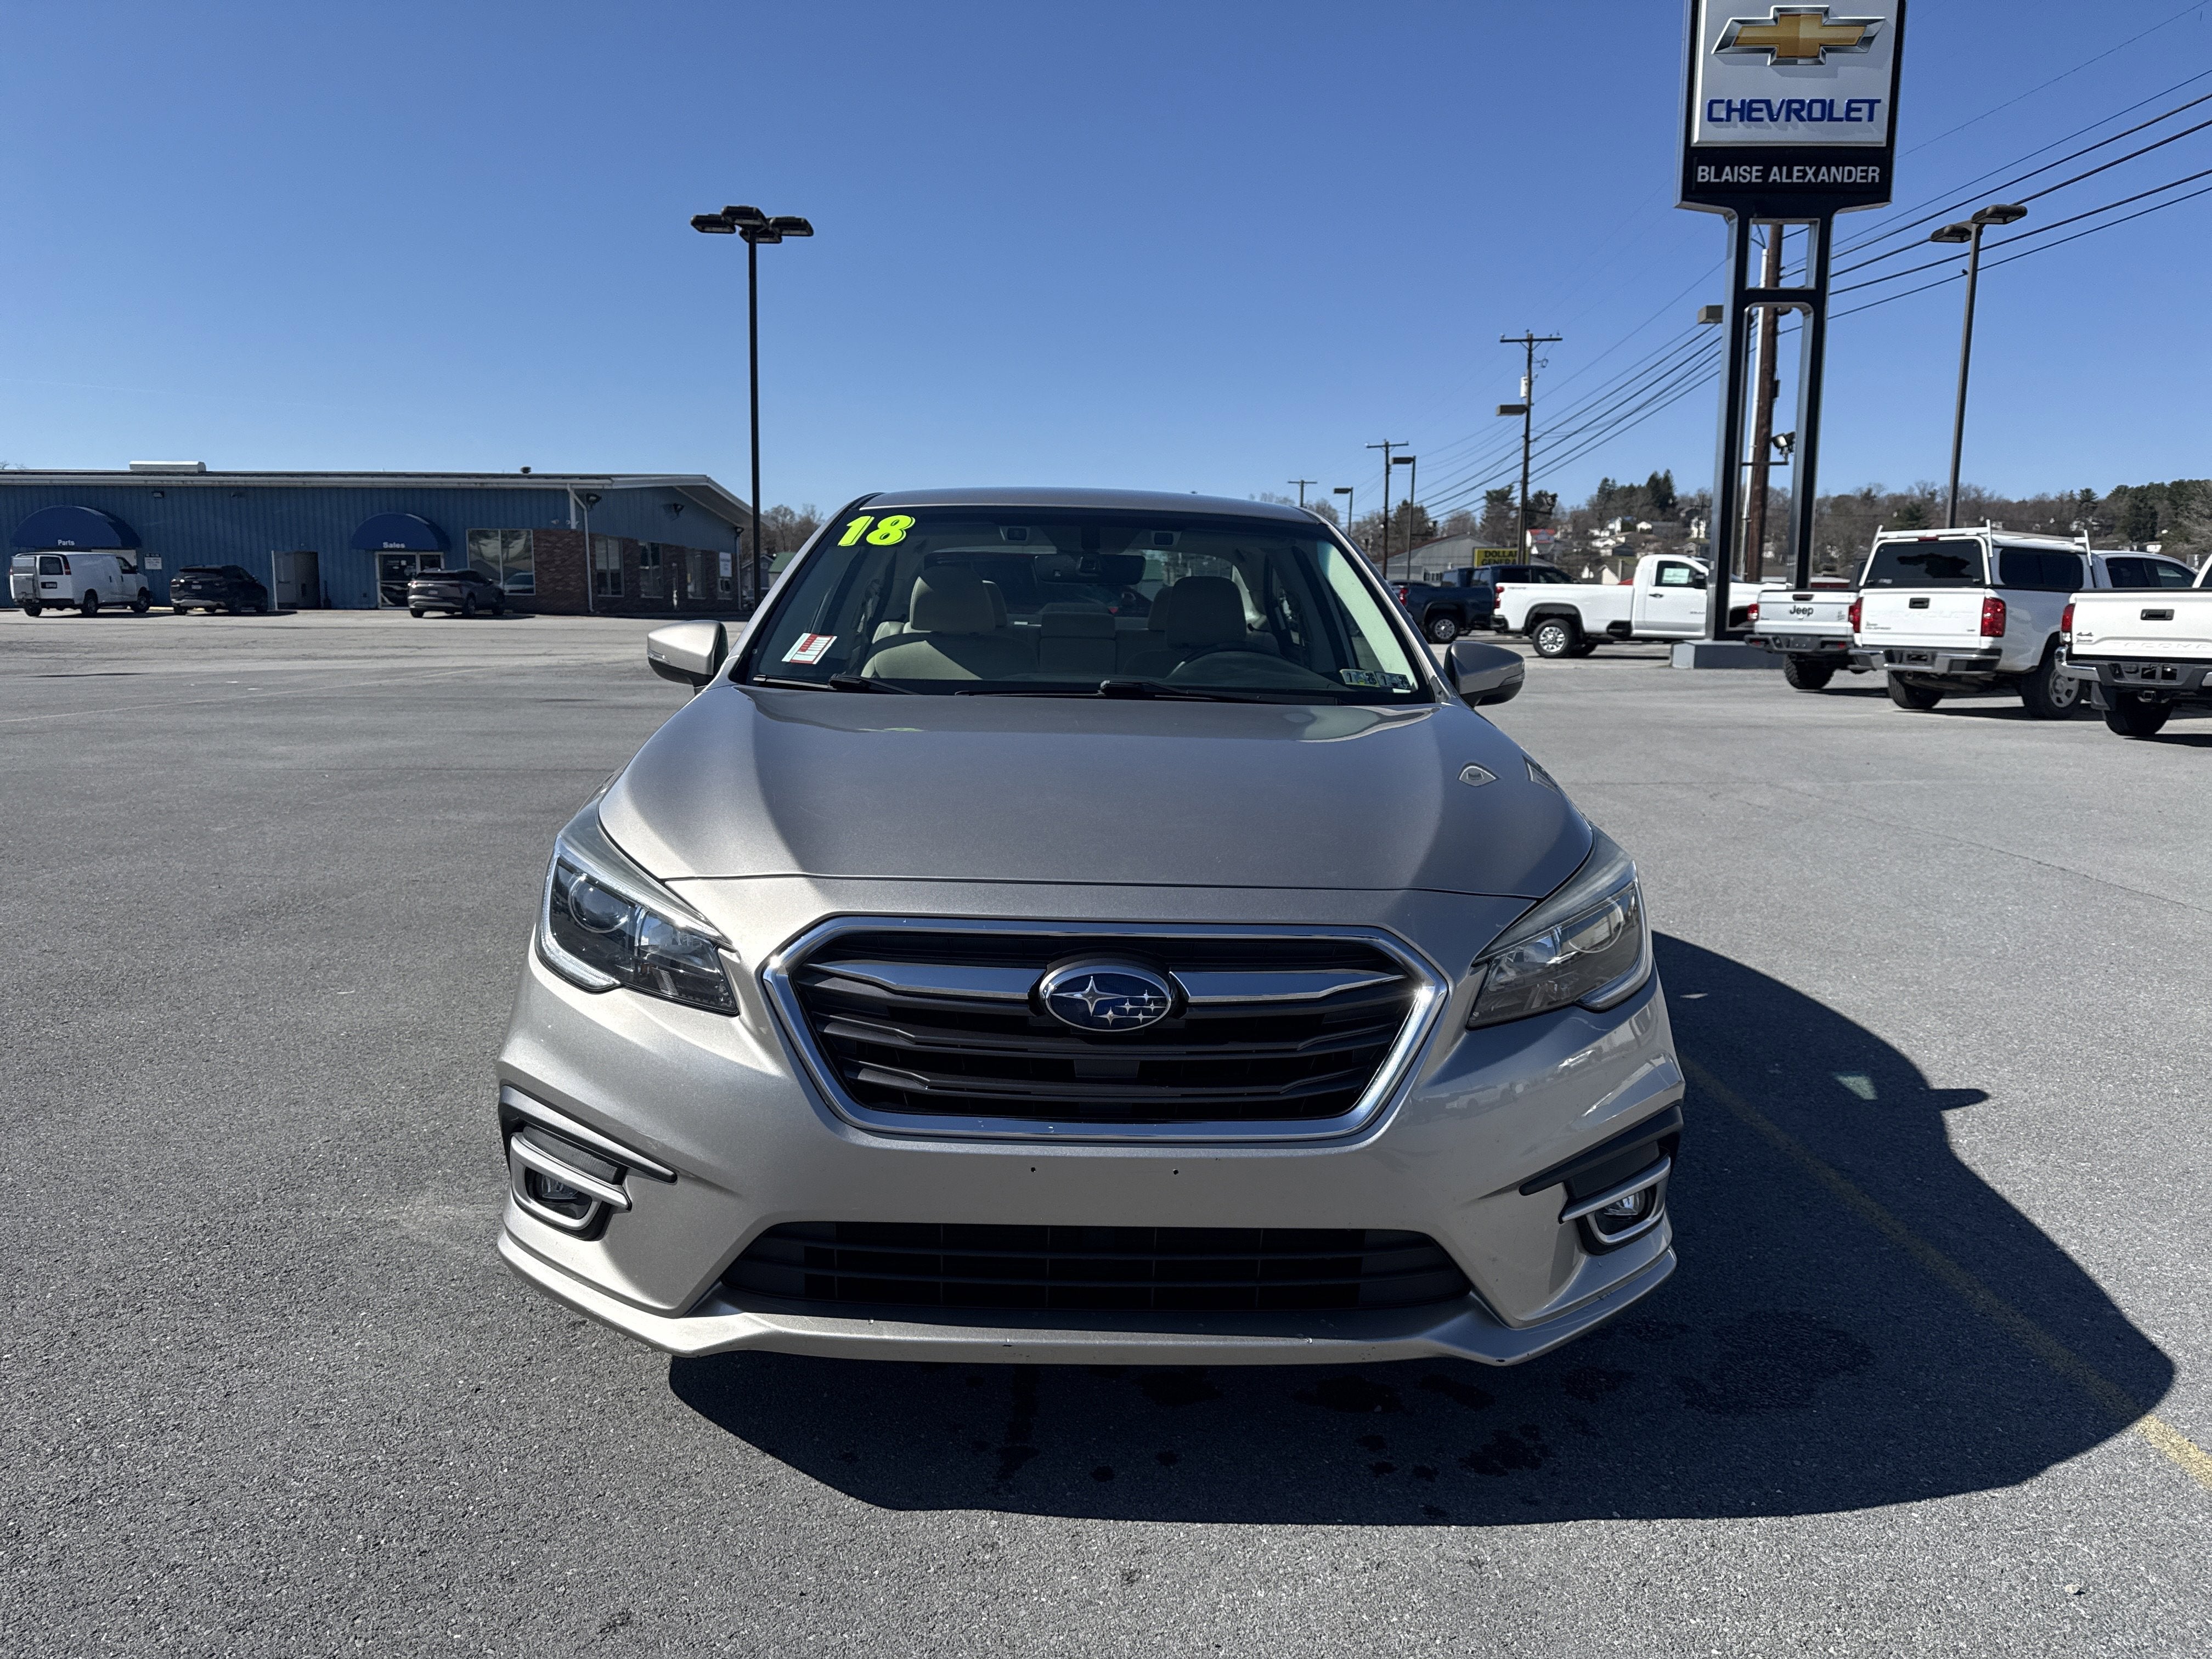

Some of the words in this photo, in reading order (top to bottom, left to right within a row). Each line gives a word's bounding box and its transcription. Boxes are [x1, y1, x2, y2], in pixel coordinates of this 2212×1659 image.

[1707, 99, 1881, 122] CHEVROLET
[1697, 166, 1763, 183] BLAISE
[1768, 166, 1880, 183] ALEXANDER
[838, 515, 916, 546] 18
[1790, 605, 1814, 616] Jeep
